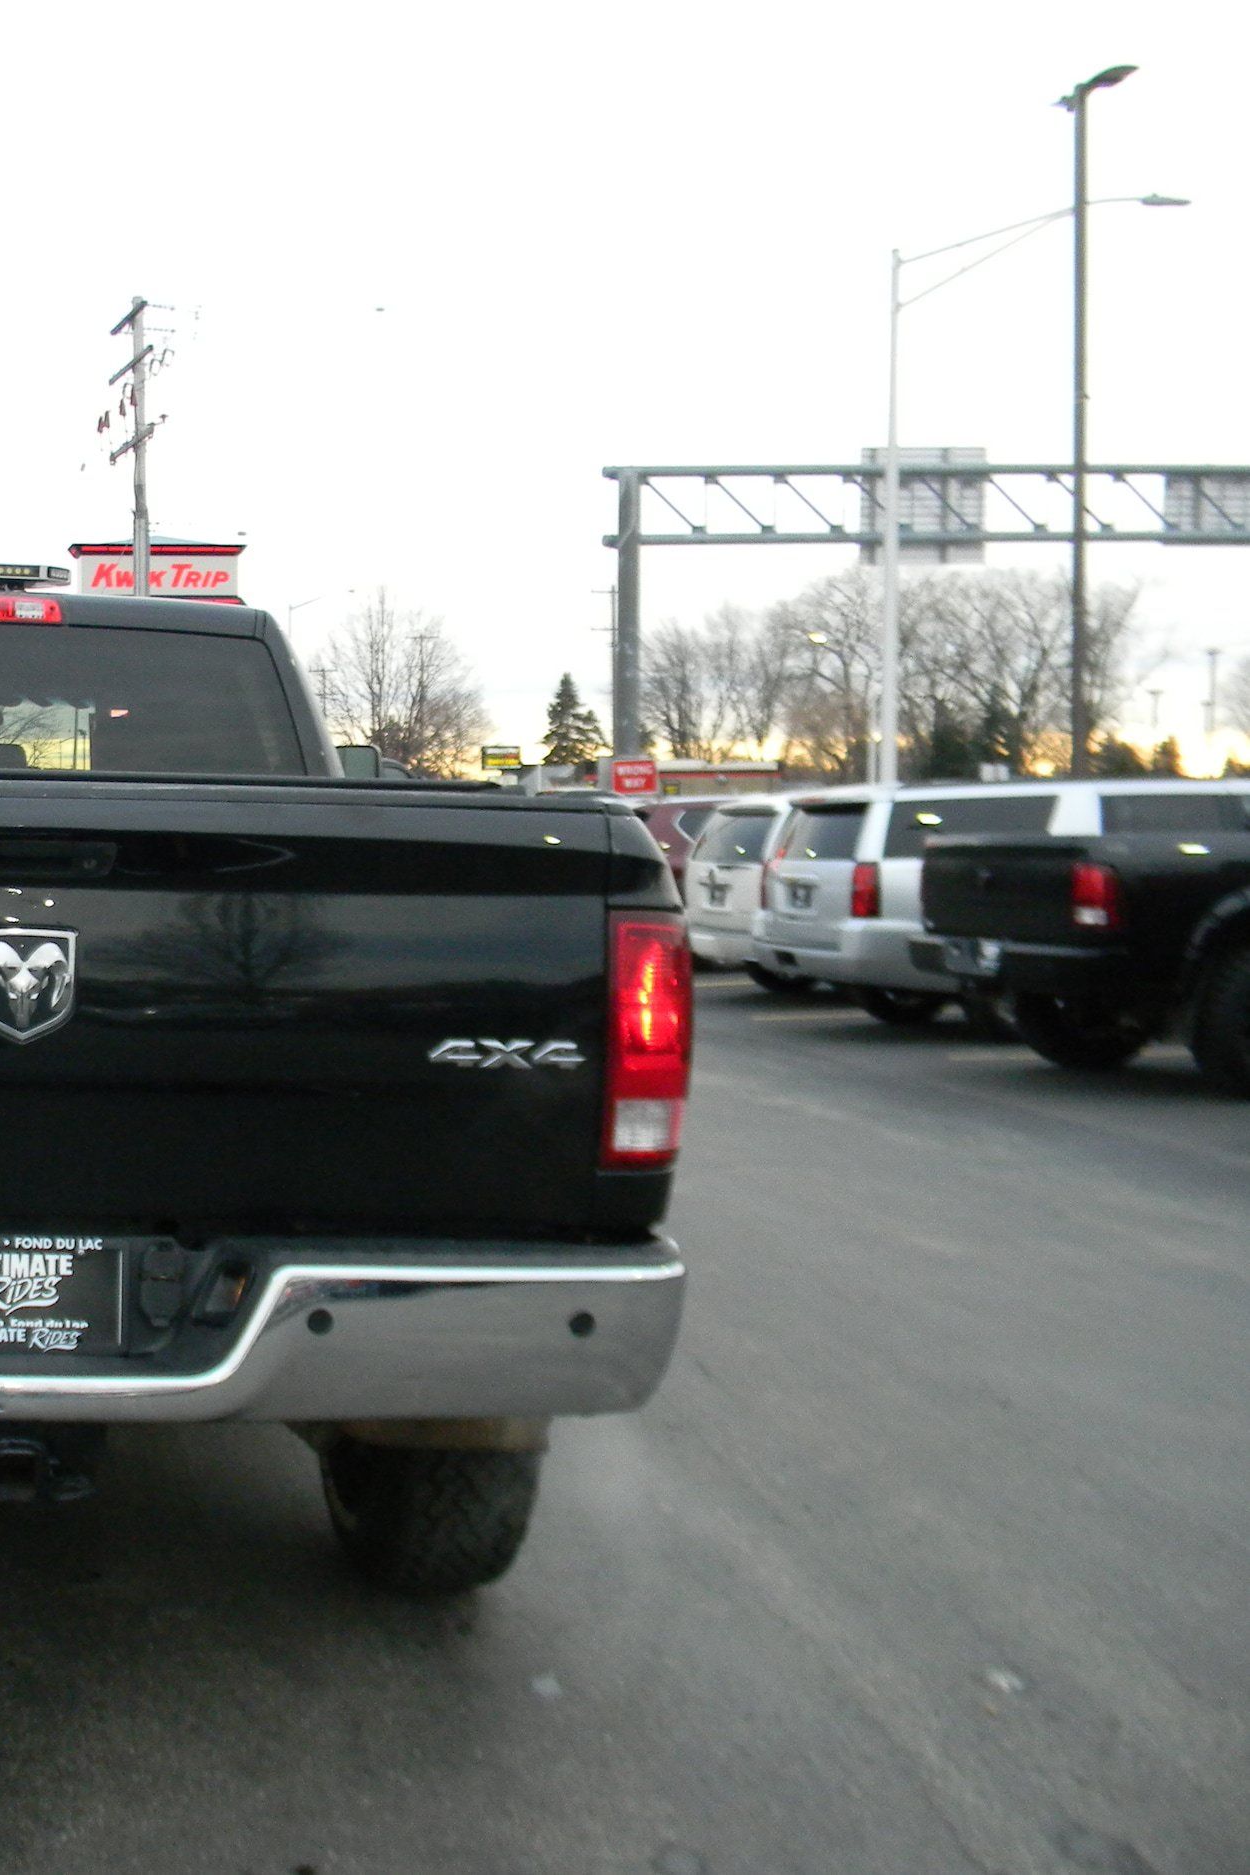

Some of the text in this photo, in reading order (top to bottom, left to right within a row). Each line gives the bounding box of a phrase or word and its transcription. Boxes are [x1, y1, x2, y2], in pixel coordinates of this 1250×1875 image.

[90, 563, 231, 588] KWK TRIP
[14, 1238, 53, 1249] FOND
[56, 1239, 75, 1250] DU
[79, 1238, 103, 1250] LAC
[29, 1328, 83, 1352] RIDES
